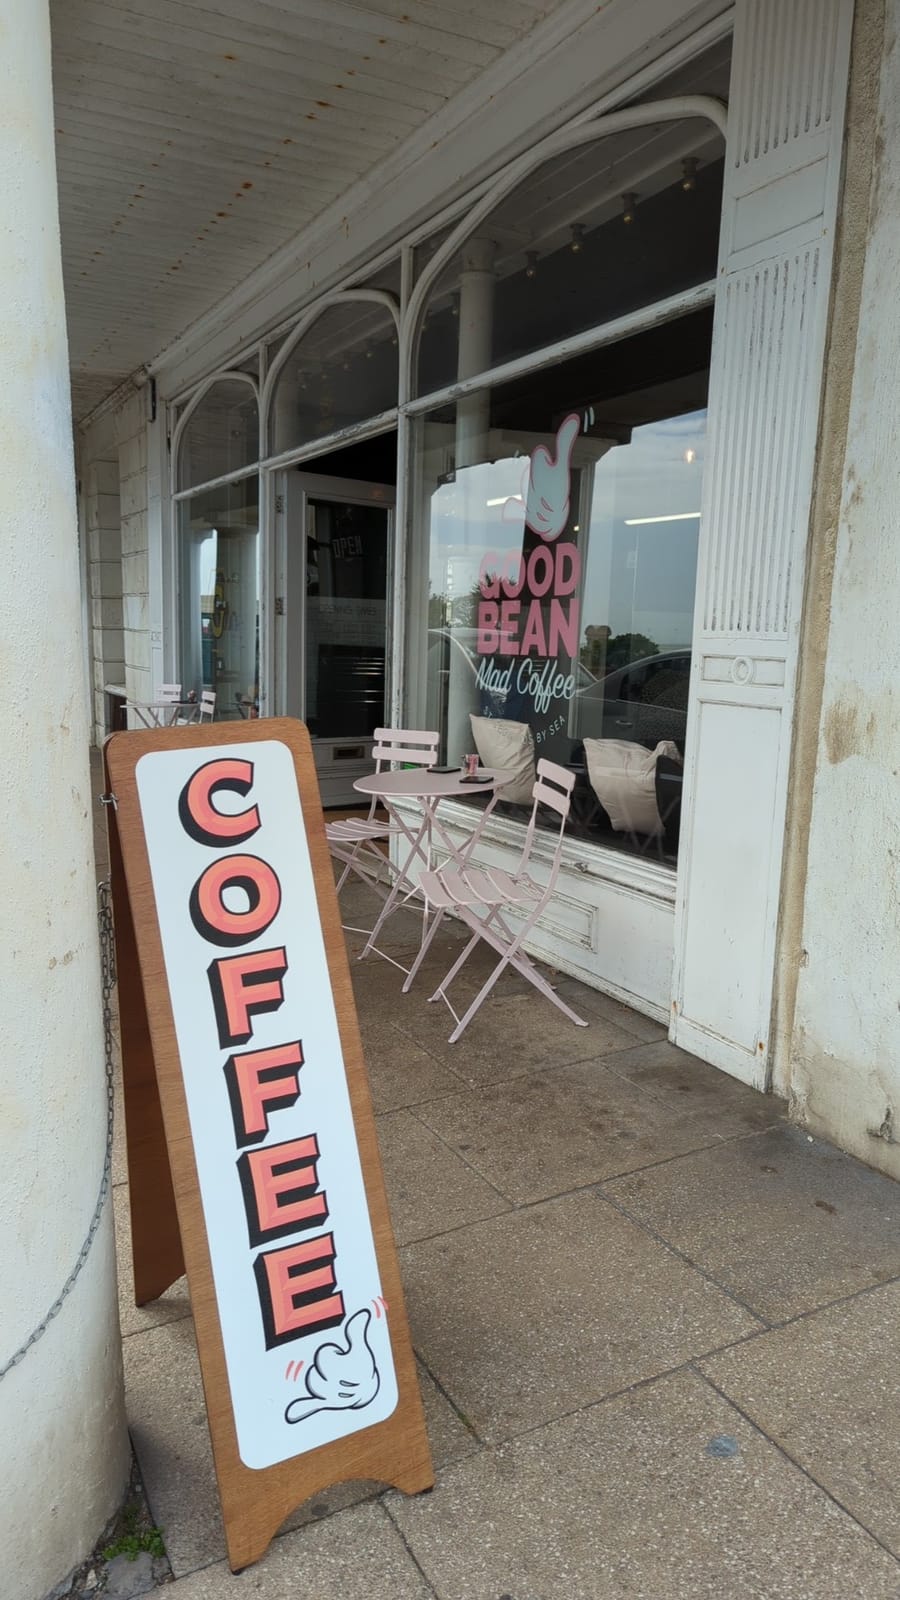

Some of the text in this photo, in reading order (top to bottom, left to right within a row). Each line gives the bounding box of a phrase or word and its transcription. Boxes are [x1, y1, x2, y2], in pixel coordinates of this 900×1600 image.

[333, 536, 363, 559] OPEN
[480, 543, 581, 599] GOOD
[477, 598, 579, 658] BEAN
[475, 657, 576, 714] Mad Coffee
[536, 730, 547, 743] BY
[549, 715, 566, 736] SEA
[178, 758, 346, 1351] COFFEE
